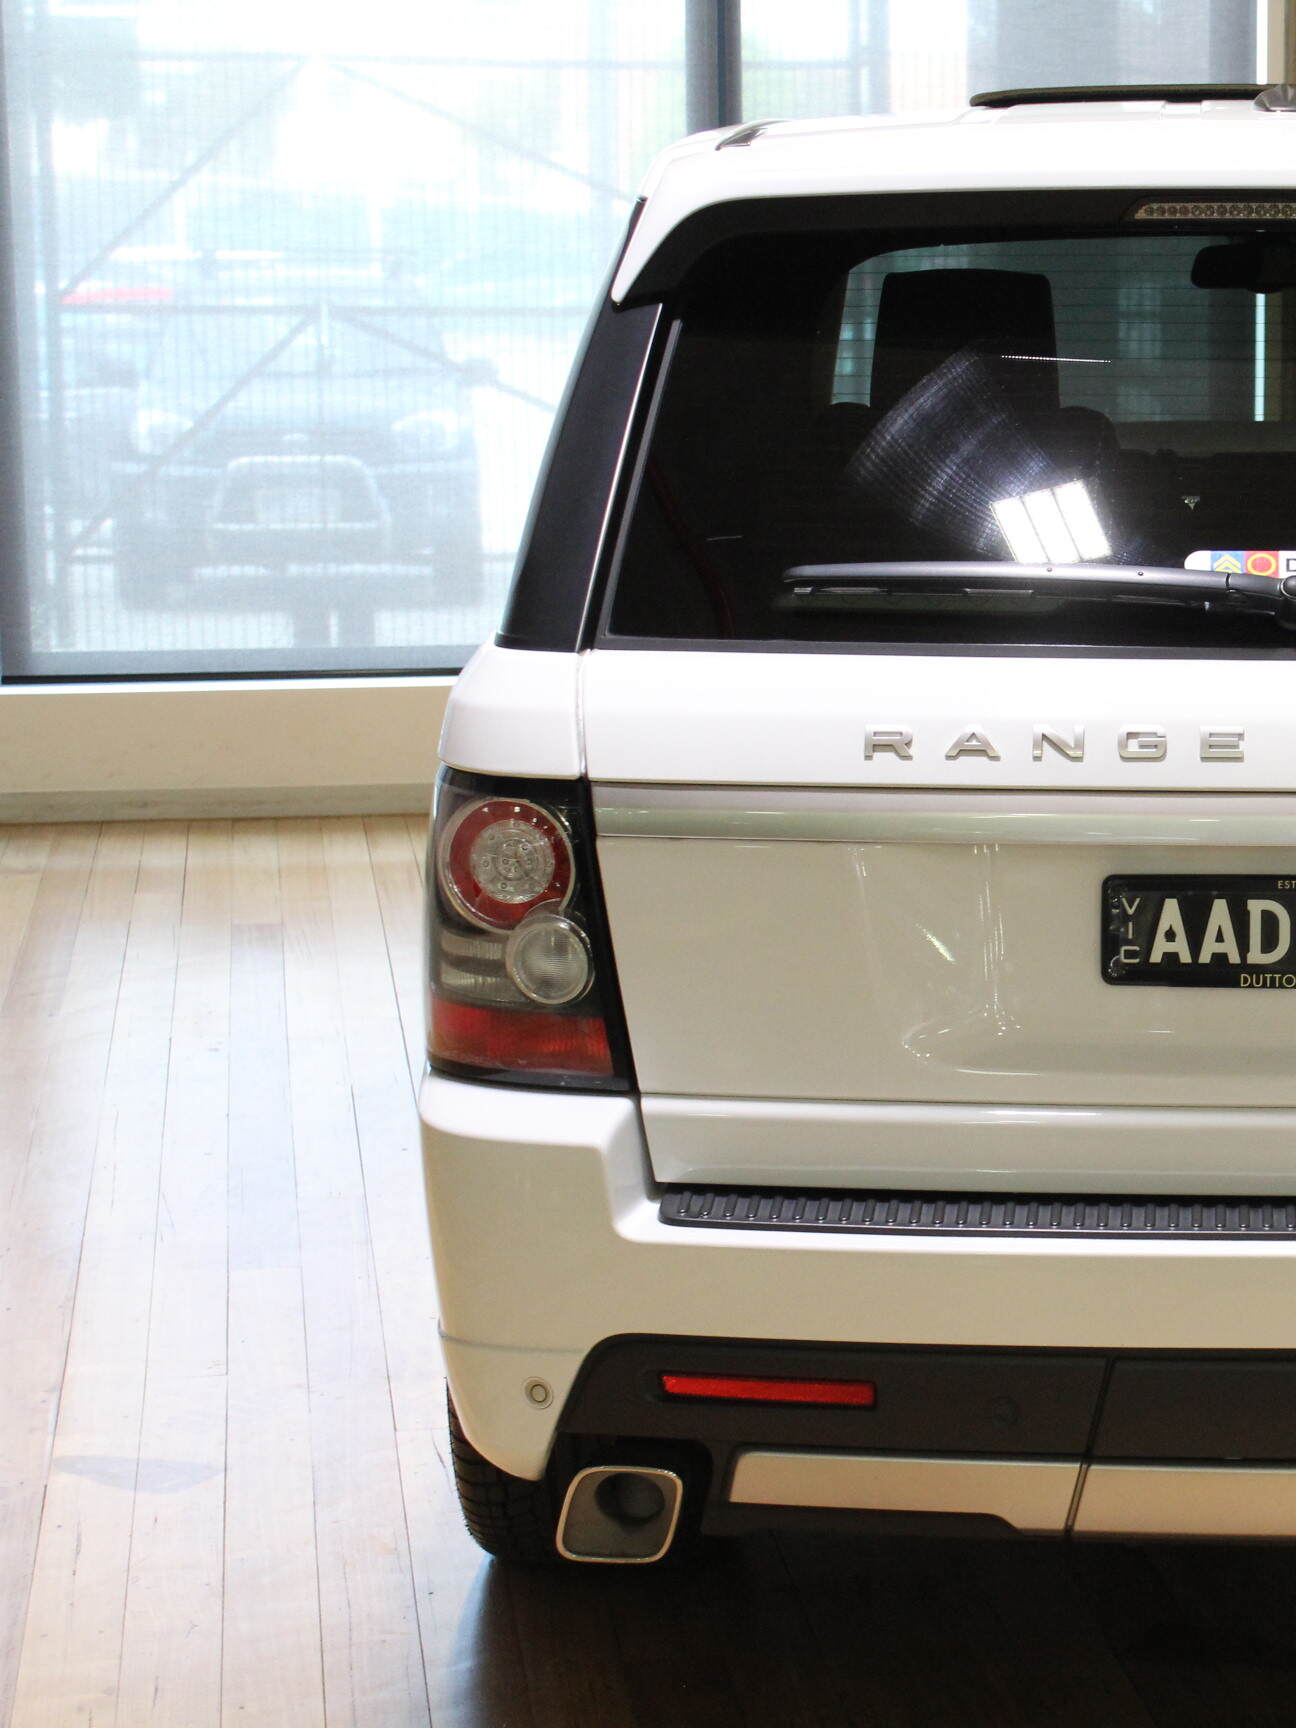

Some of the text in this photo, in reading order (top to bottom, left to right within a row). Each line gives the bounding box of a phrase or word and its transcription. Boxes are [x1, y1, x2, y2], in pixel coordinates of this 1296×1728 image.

[864, 723, 1245, 763] RANGE
[1277, 880, 1296, 889] EST
[1120, 897, 1141, 964] VIC
[1148, 898, 1291, 965] AAD
